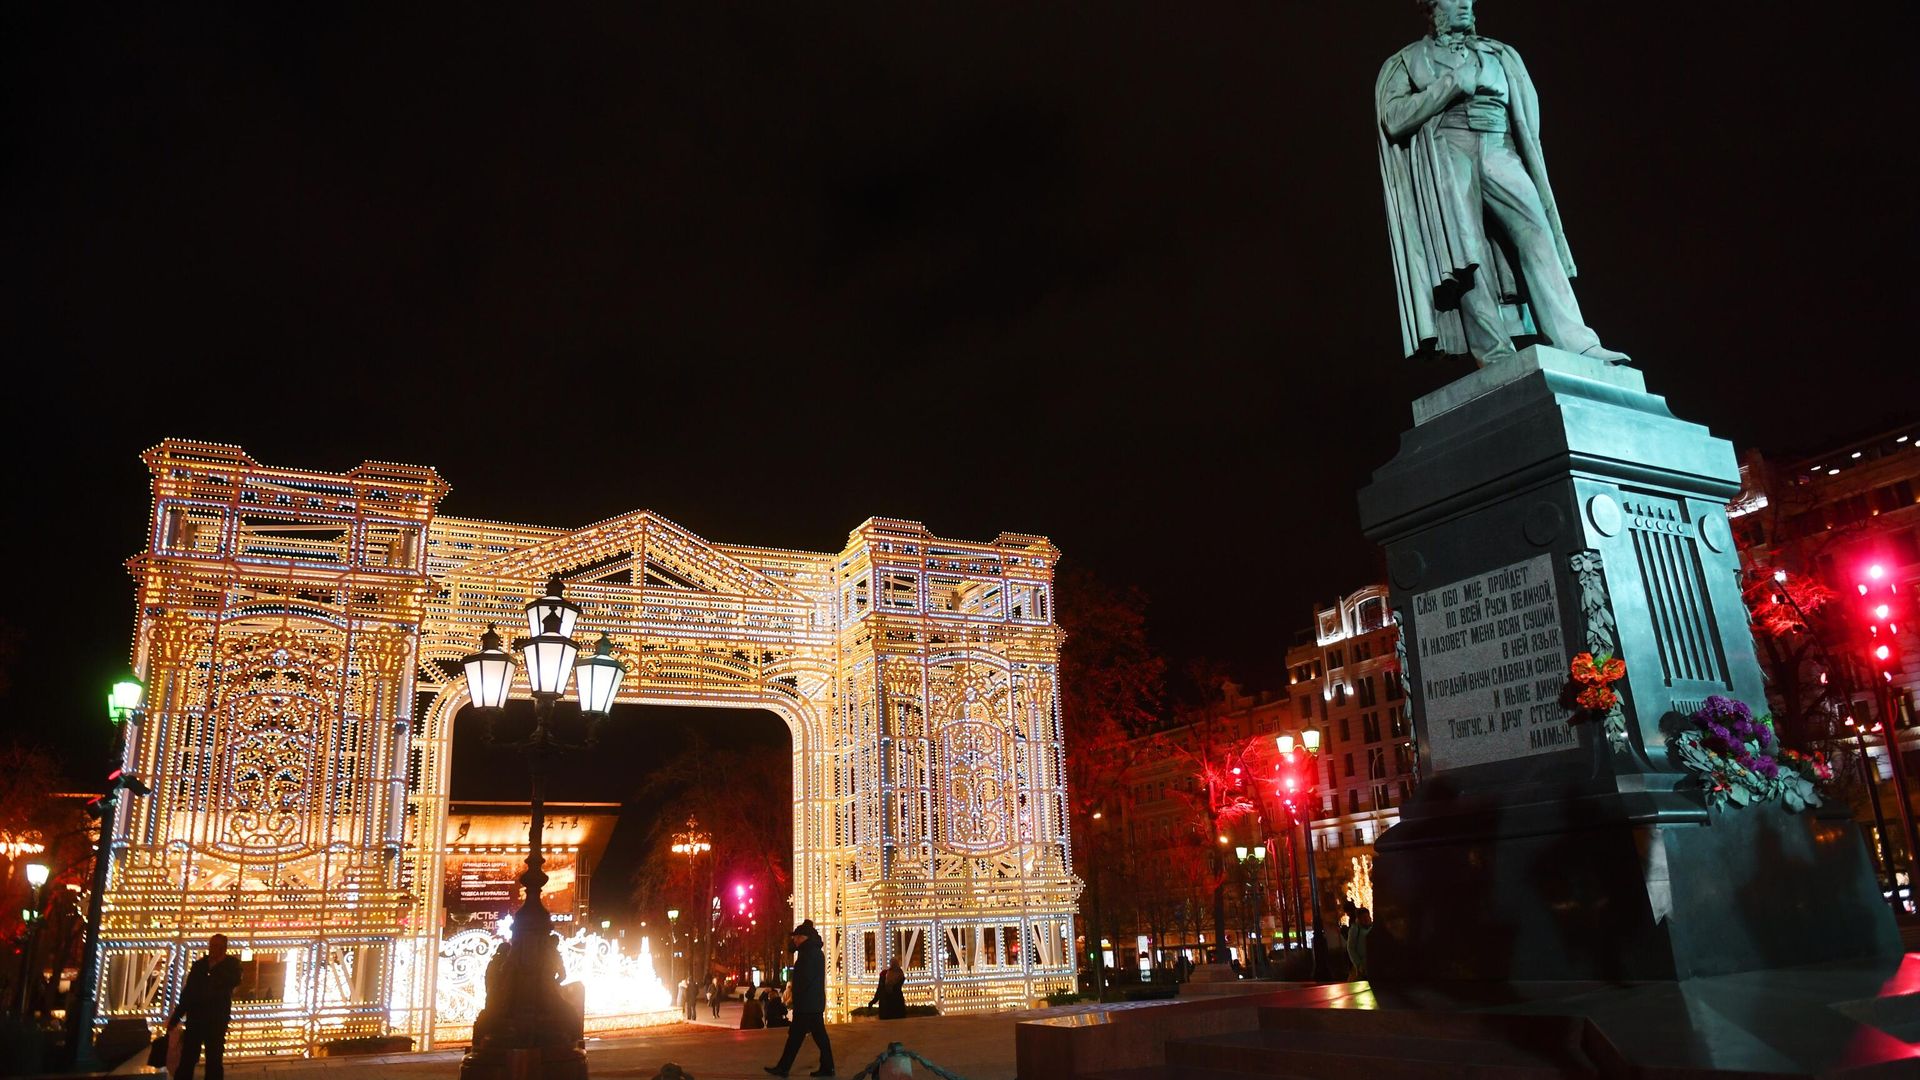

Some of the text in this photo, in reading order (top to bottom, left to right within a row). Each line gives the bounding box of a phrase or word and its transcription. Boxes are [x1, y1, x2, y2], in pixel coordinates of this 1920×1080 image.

[1442, 588, 1459, 608] ОБО
[1463, 581, 1483, 602] МНЕ
[1487, 566, 1529, 594] ПРОЙДЕТ
[1445, 610, 1457, 629] ПО
[1460, 600, 1482, 625] ВСЕЙ
[1484, 596, 1508, 618] РУСИ
[1421, 602, 1556, 658] И НАЗОВЕТ МЕНЯ ВСЯК СУЩИЙ
[1502, 642, 1509, 660] В
[1511, 633, 1529, 658] НЕЙ
[1427, 680, 1434, 700] И
[1434, 671, 1468, 697] ГОРДЫЙ
[1468, 669, 1491, 691] ВНУК
[1493, 689, 1501, 709] И
[1503, 683, 1531, 706] НЫНЕ
[1487, 713, 1496, 733] И
[1501, 708, 1523, 733] ДРУГ
[522, 821, 578, 831] ТАТР
[550, 914, 573, 922] ССЫ
